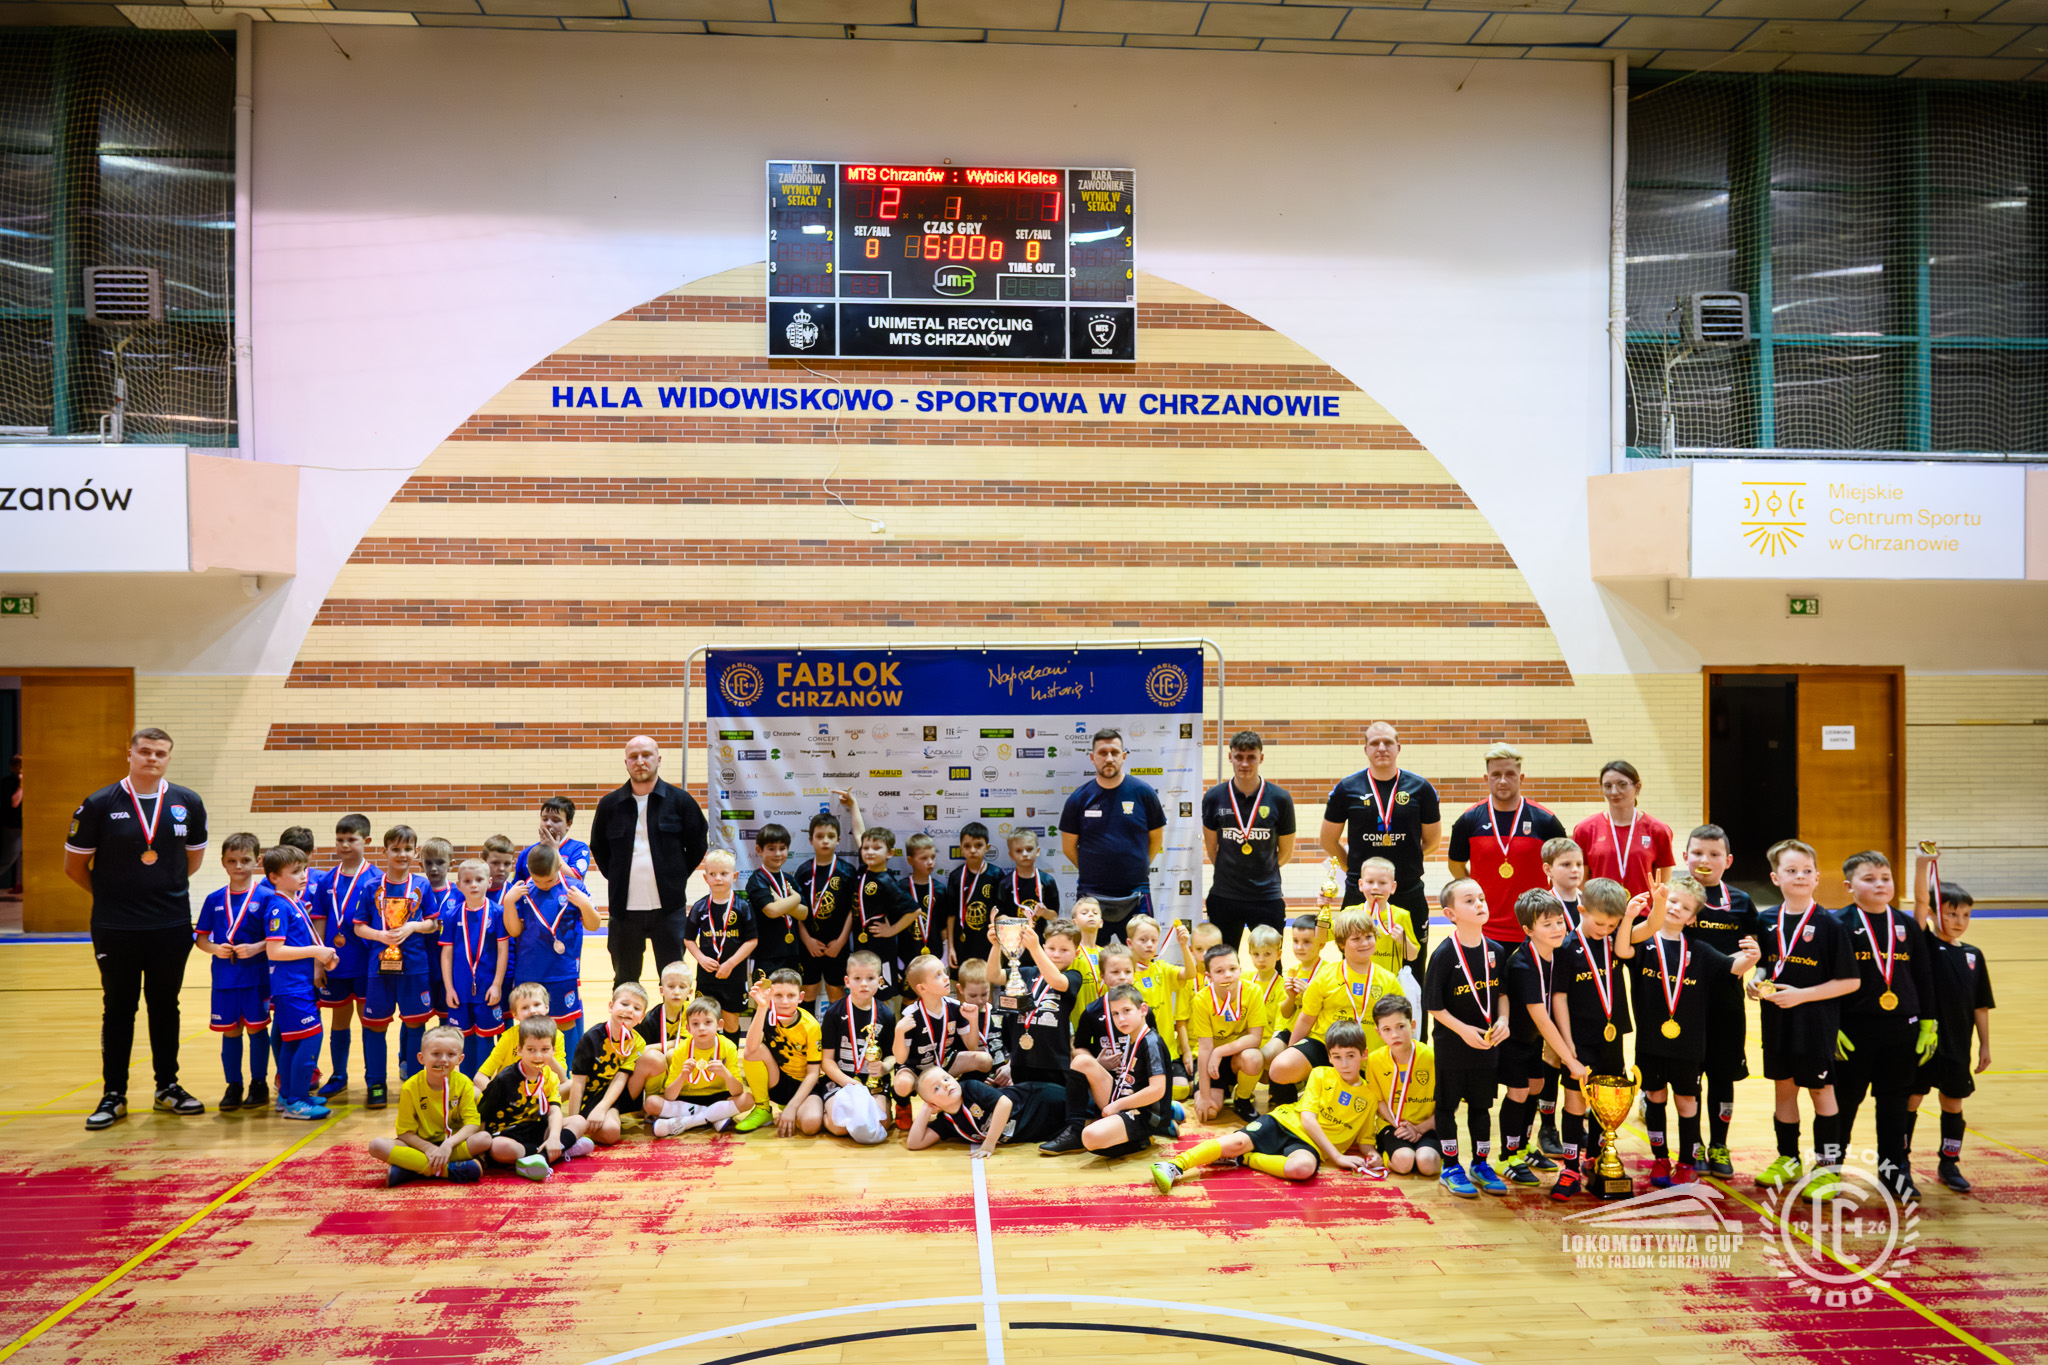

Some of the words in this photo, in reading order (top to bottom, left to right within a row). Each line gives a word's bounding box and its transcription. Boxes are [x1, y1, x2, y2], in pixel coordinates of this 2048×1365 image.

[792, 164, 813, 174] KARA
[779, 173, 826, 184] ZAWODNIKA
[848, 167, 876, 181] MTS
[879, 167, 945, 183] Chrzanów
[966, 169, 1015, 186] Wybicki
[1018, 170, 1058, 185] Kielce
[1091, 170, 1112, 181] KARA
[782, 185, 810, 196] WYNIK
[813, 185, 822, 196] W
[1078, 179, 1124, 191] ZAWODNIKA
[788, 196, 817, 206] SETACH
[1081, 191, 1109, 202] WYNIK
[1111, 192, 1121, 202] W
[879, 187, 901, 219] 2
[1087, 201, 1116, 212] SETACH
[1124, 204, 1132, 215] 4
[854, 226, 891, 237] SET/FAUL
[923, 221, 954, 234] CZAS
[957, 222, 983, 235] GRY
[771, 230, 777, 241] 2
[827, 231, 833, 241] 2
[1016, 229, 1052, 240] SET/FAUL
[1125, 236, 1132, 248] 5
[770, 262, 777, 273] 3
[826, 262, 833, 274] 3
[1008, 262, 1033, 273] TIME
[1035, 263, 1056, 274] OUT
[1070, 268, 1077, 278] 3
[1126, 269, 1133, 279] 6
[868, 315, 945, 331] UNIMETAL
[947, 317, 1034, 332] RECYCLING
[1095, 324, 1109, 333] MTS
[889, 332, 922, 346] MTS
[924, 331, 1012, 347] CHRZANÓW
[552, 385, 643, 409] HALA
[658, 386, 894, 412] WIDOWISKOWO
[915, 388, 1088, 415] SPORTOWA
[1099, 392, 1127, 415] W
[1138, 393, 1340, 417] CHRZANOWIE
[1828, 483, 1904, 503] Miejskie
[1829, 508, 1913, 526] Centrum
[1917, 509, 1982, 529] Sportu
[1829, 537, 1844, 551] w
[1848, 533, 1960, 552] Chrzanowie
[777, 661, 903, 688] FABLOK
[776, 685, 904, 708] CHRZANÓW
